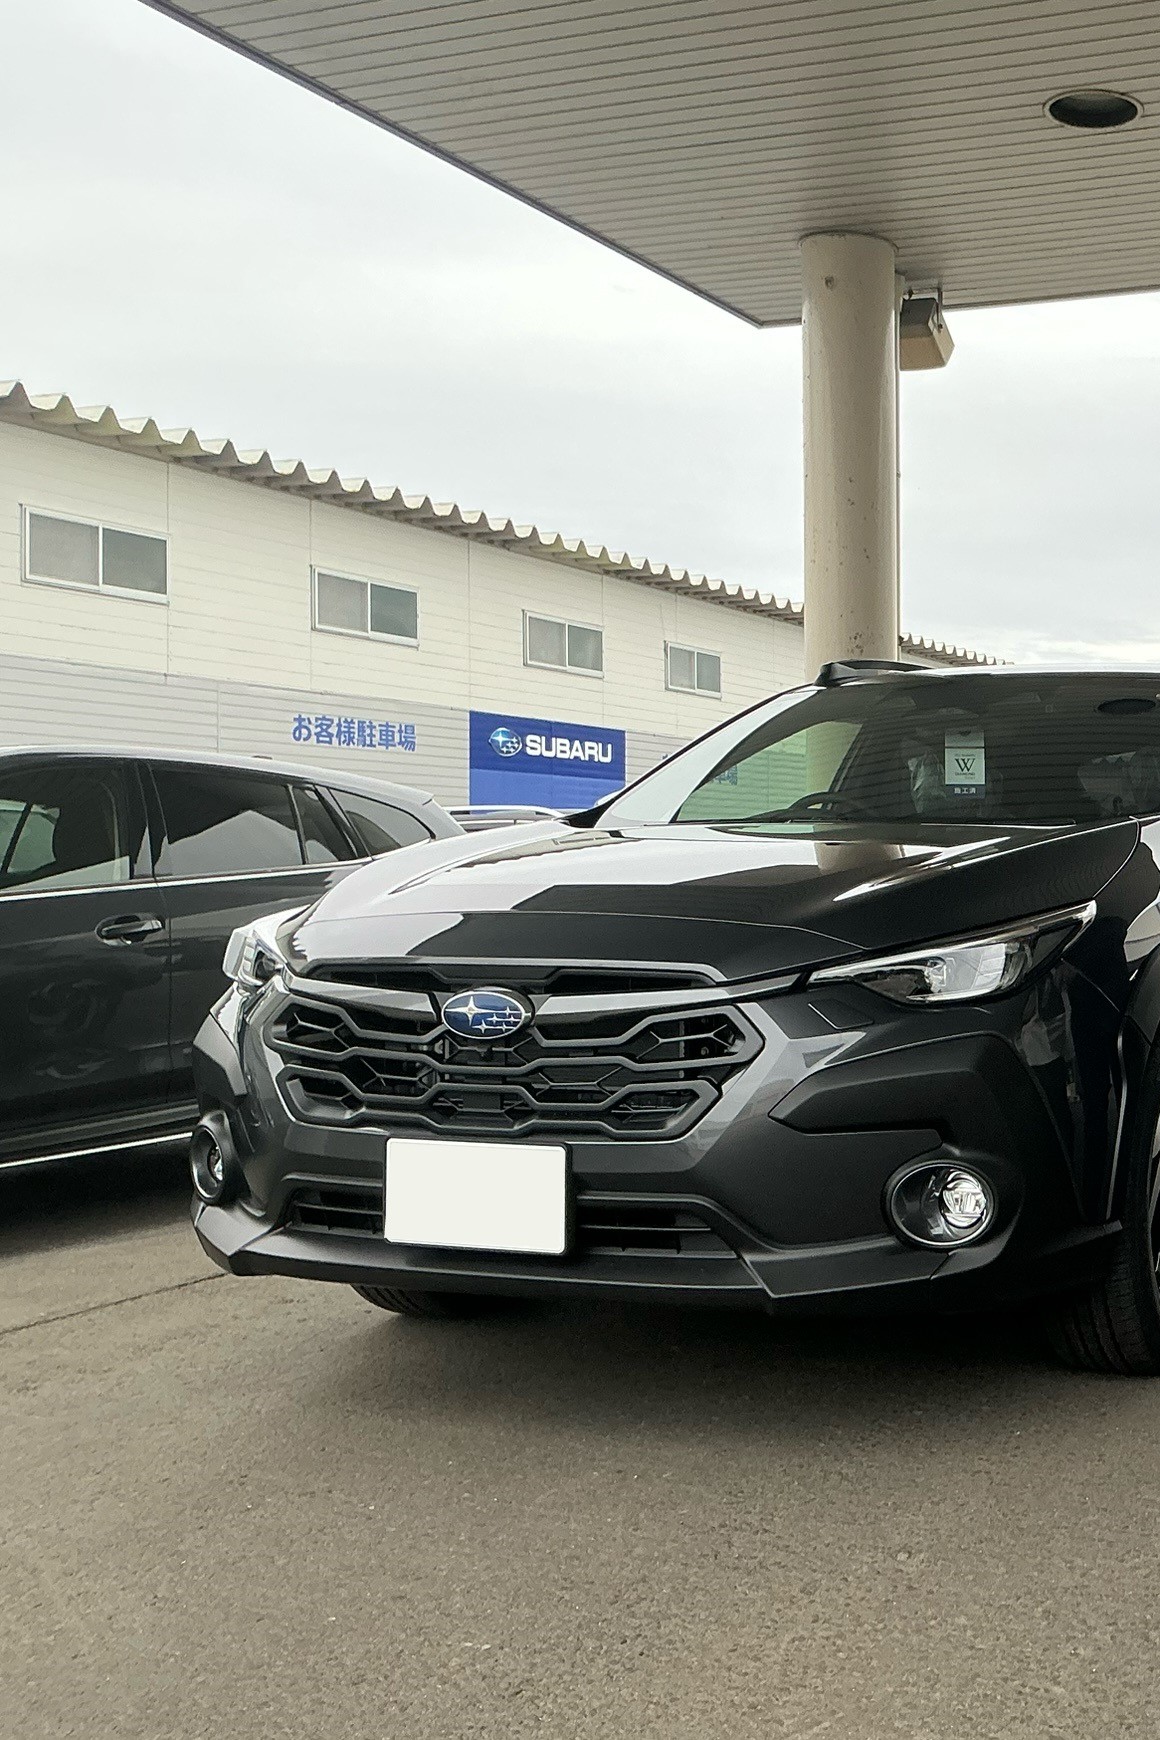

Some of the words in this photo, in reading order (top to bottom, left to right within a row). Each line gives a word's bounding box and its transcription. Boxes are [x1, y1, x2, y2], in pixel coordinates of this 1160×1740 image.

[292, 714, 416, 752] お客様駐車場
[525, 734, 613, 764] SUBARU
[954, 758, 976, 772] W
